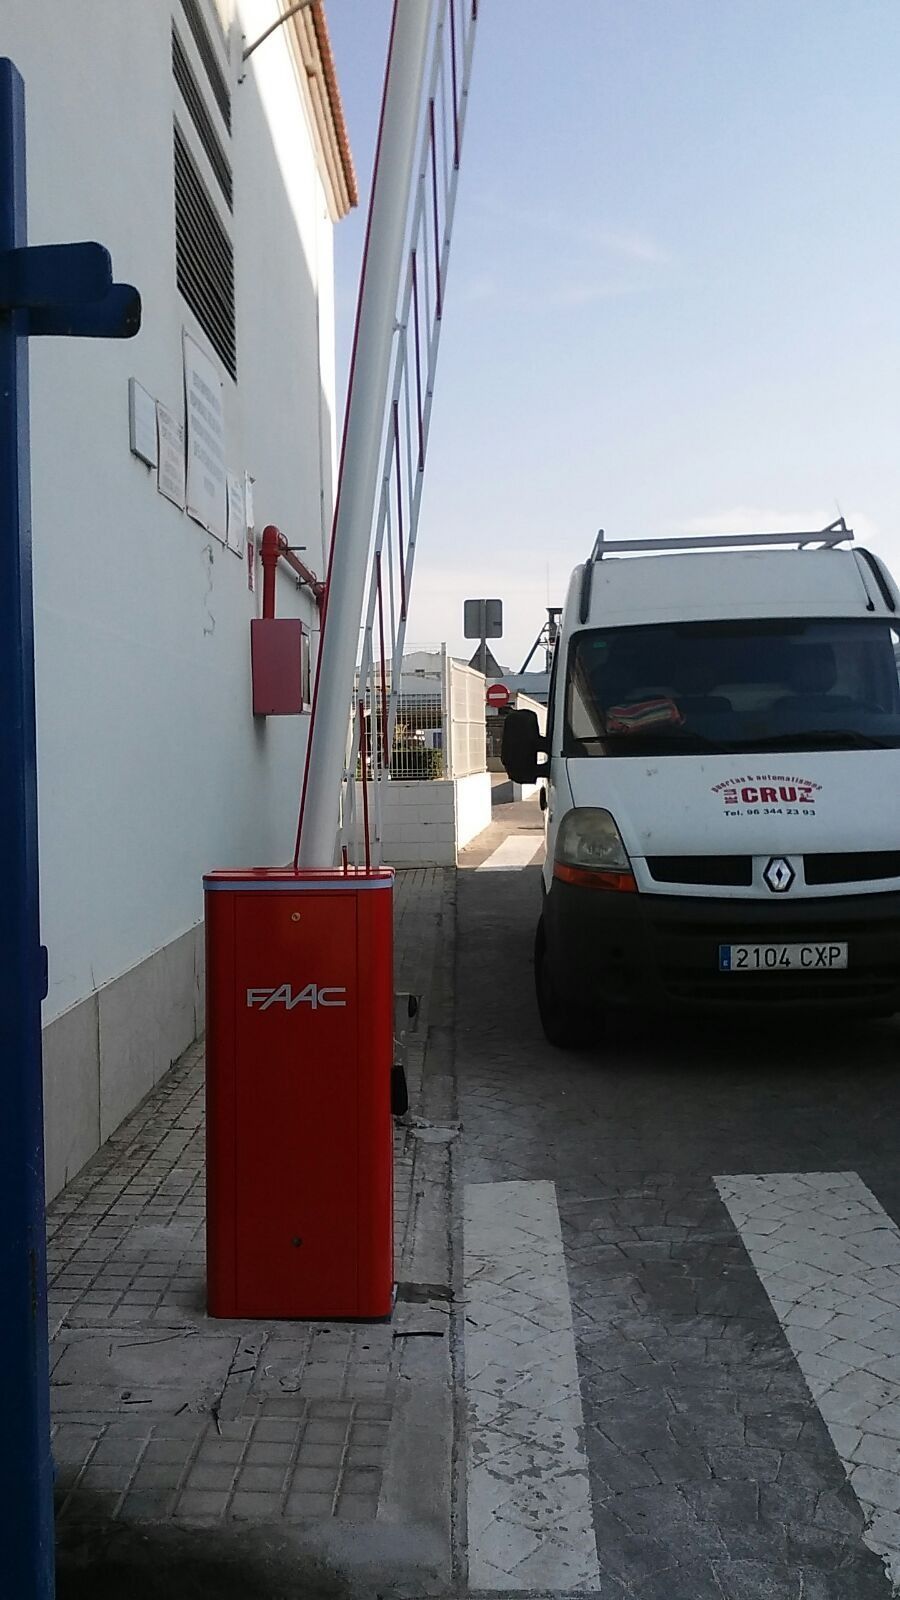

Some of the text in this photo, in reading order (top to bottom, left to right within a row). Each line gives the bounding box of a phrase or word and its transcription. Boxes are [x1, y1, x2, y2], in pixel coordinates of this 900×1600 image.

[756, 774, 823, 790] automatismos
[741, 786, 815, 803] CRUZ
[737, 946, 841, 967] 2104 CXP
[247, 984, 346, 1010] FAAC
